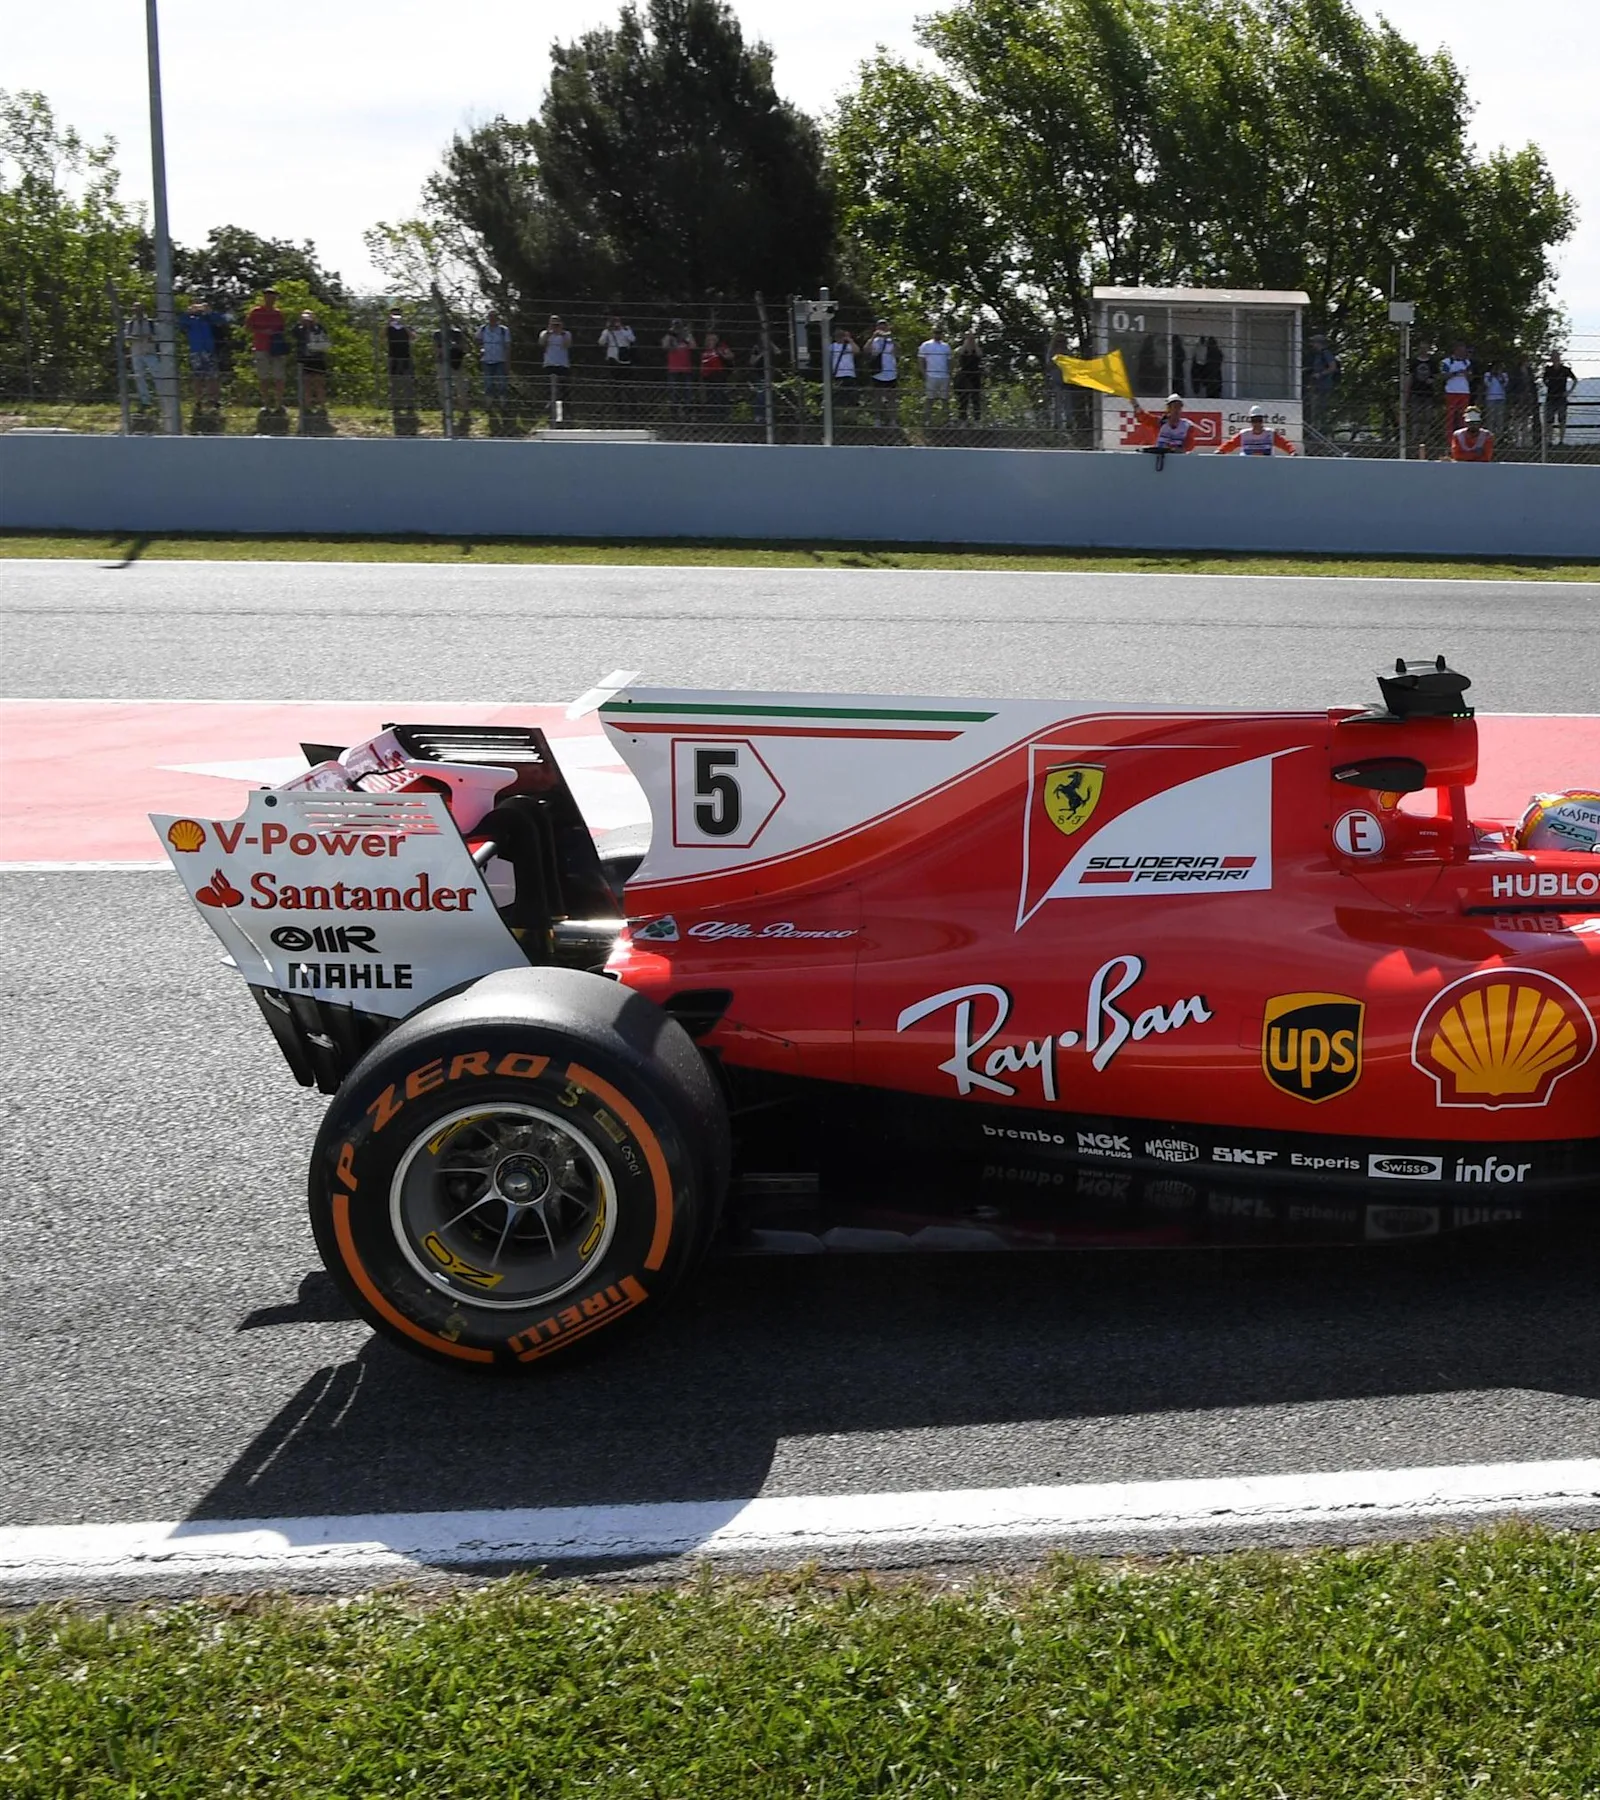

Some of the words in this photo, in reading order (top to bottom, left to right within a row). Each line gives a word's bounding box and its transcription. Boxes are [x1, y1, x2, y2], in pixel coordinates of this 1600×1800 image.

[1272, 413, 1286, 424] de
[693, 747, 740, 837] 5
[211, 822, 406, 857] V-Power
[1348, 815, 1371, 852] E
[1086, 856, 1219, 869] SCUDERIA
[1134, 870, 1250, 882] FERRARI
[250, 872, 477, 912] Santander
[687, 921, 754, 942] Alfa
[757, 922, 859, 939] Romeo
[288, 962, 413, 989] MAHLE
[1270, 1027, 1355, 1090] ups
[336, 1142, 358, 1192] P
[366, 1051, 551, 1133] ZERO
[982, 1125, 1065, 1144] brembo
[1076, 1132, 1130, 1151] NGK
[1078, 1147, 1104, 1156] SPARK
[1105, 1150, 1133, 1159] PLUGS
[1212, 1147, 1278, 1165] SKF
[1291, 1153, 1360, 1169] Experis
[1381, 1160, 1429, 1174] Swisse
[1455, 1156, 1532, 1182] infor
[507, 1274, 649, 1363] PIRELLI
